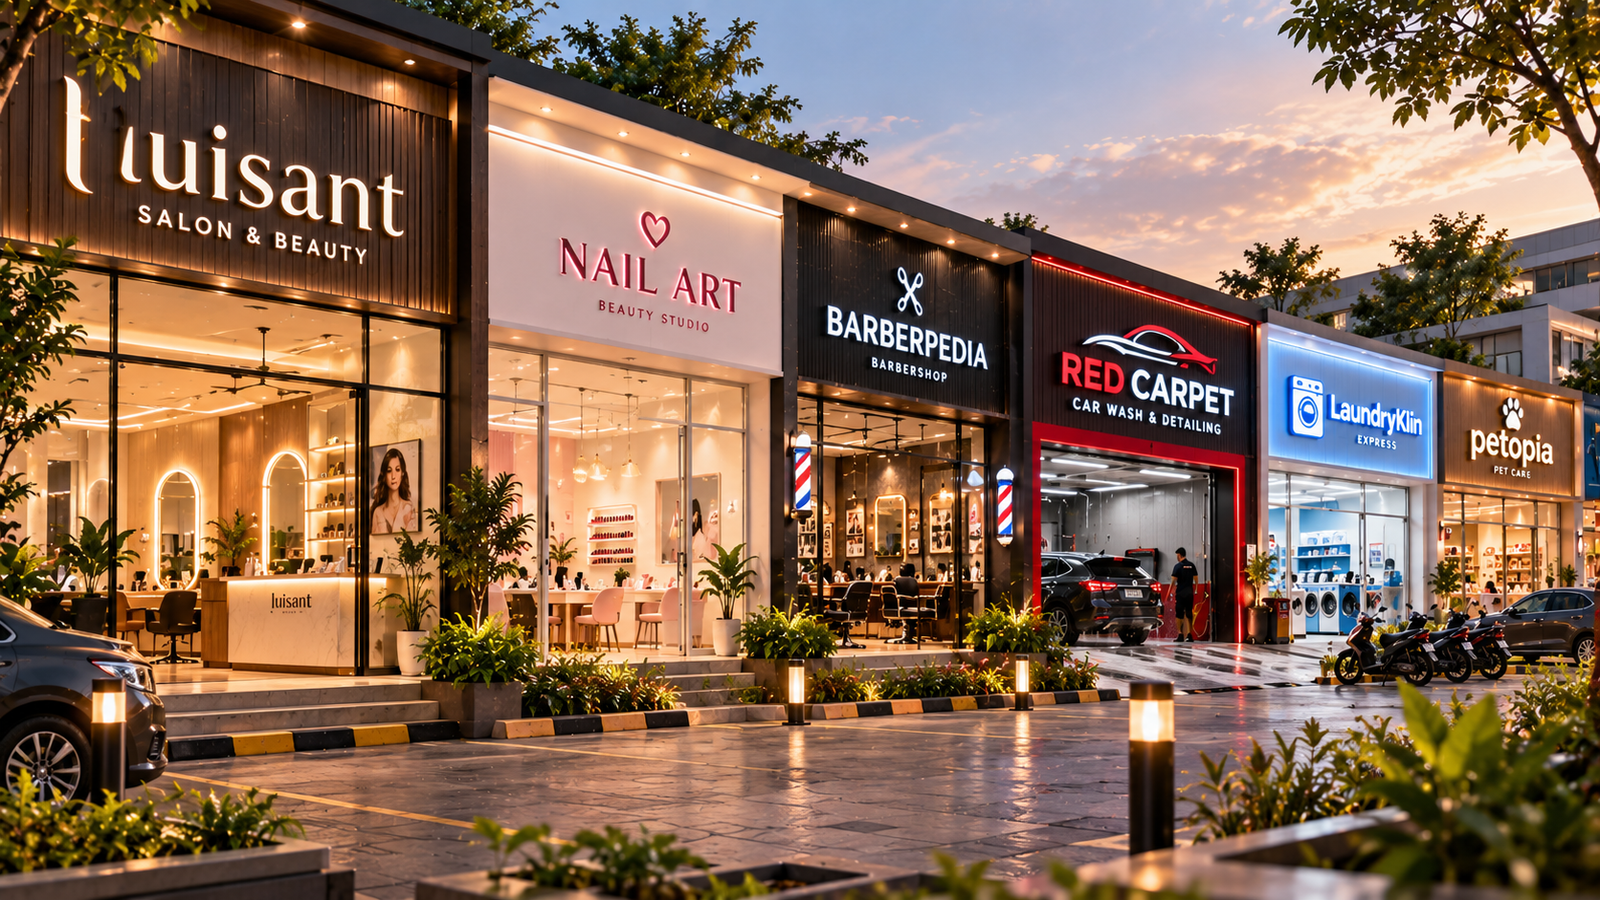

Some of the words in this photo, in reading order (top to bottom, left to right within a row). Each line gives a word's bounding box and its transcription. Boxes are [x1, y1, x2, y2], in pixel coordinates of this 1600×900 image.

[138, 204, 232, 240] SALON
[246, 226, 261, 245] &
[275, 231, 367, 265] BEAUTY
[558, 236, 658, 295] NAIL
[671, 267, 742, 314] ART
[599, 299, 654, 321] BEAUTY
[661, 313, 710, 333] STUDIO
[827, 304, 989, 370] BARBERPEDIA
[871, 356, 948, 383] BARBERSHOP
[1061, 351, 1126, 395] RED
[1131, 368, 1235, 417] CARPET
[1072, 397, 1101, 414] CAR
[1106, 403, 1143, 422] WASH
[1148, 411, 1157, 424] &
[1162, 413, 1222, 435] DETAILING
[1328, 393, 1423, 436] LaundryKlin
[1357, 434, 1397, 450] EXPRESS
[1470, 429, 1554, 468] petopia
[1493, 465, 1508, 476] PET
[1510, 467, 1531, 479] CARE
[271, 592, 312, 609] luisant
